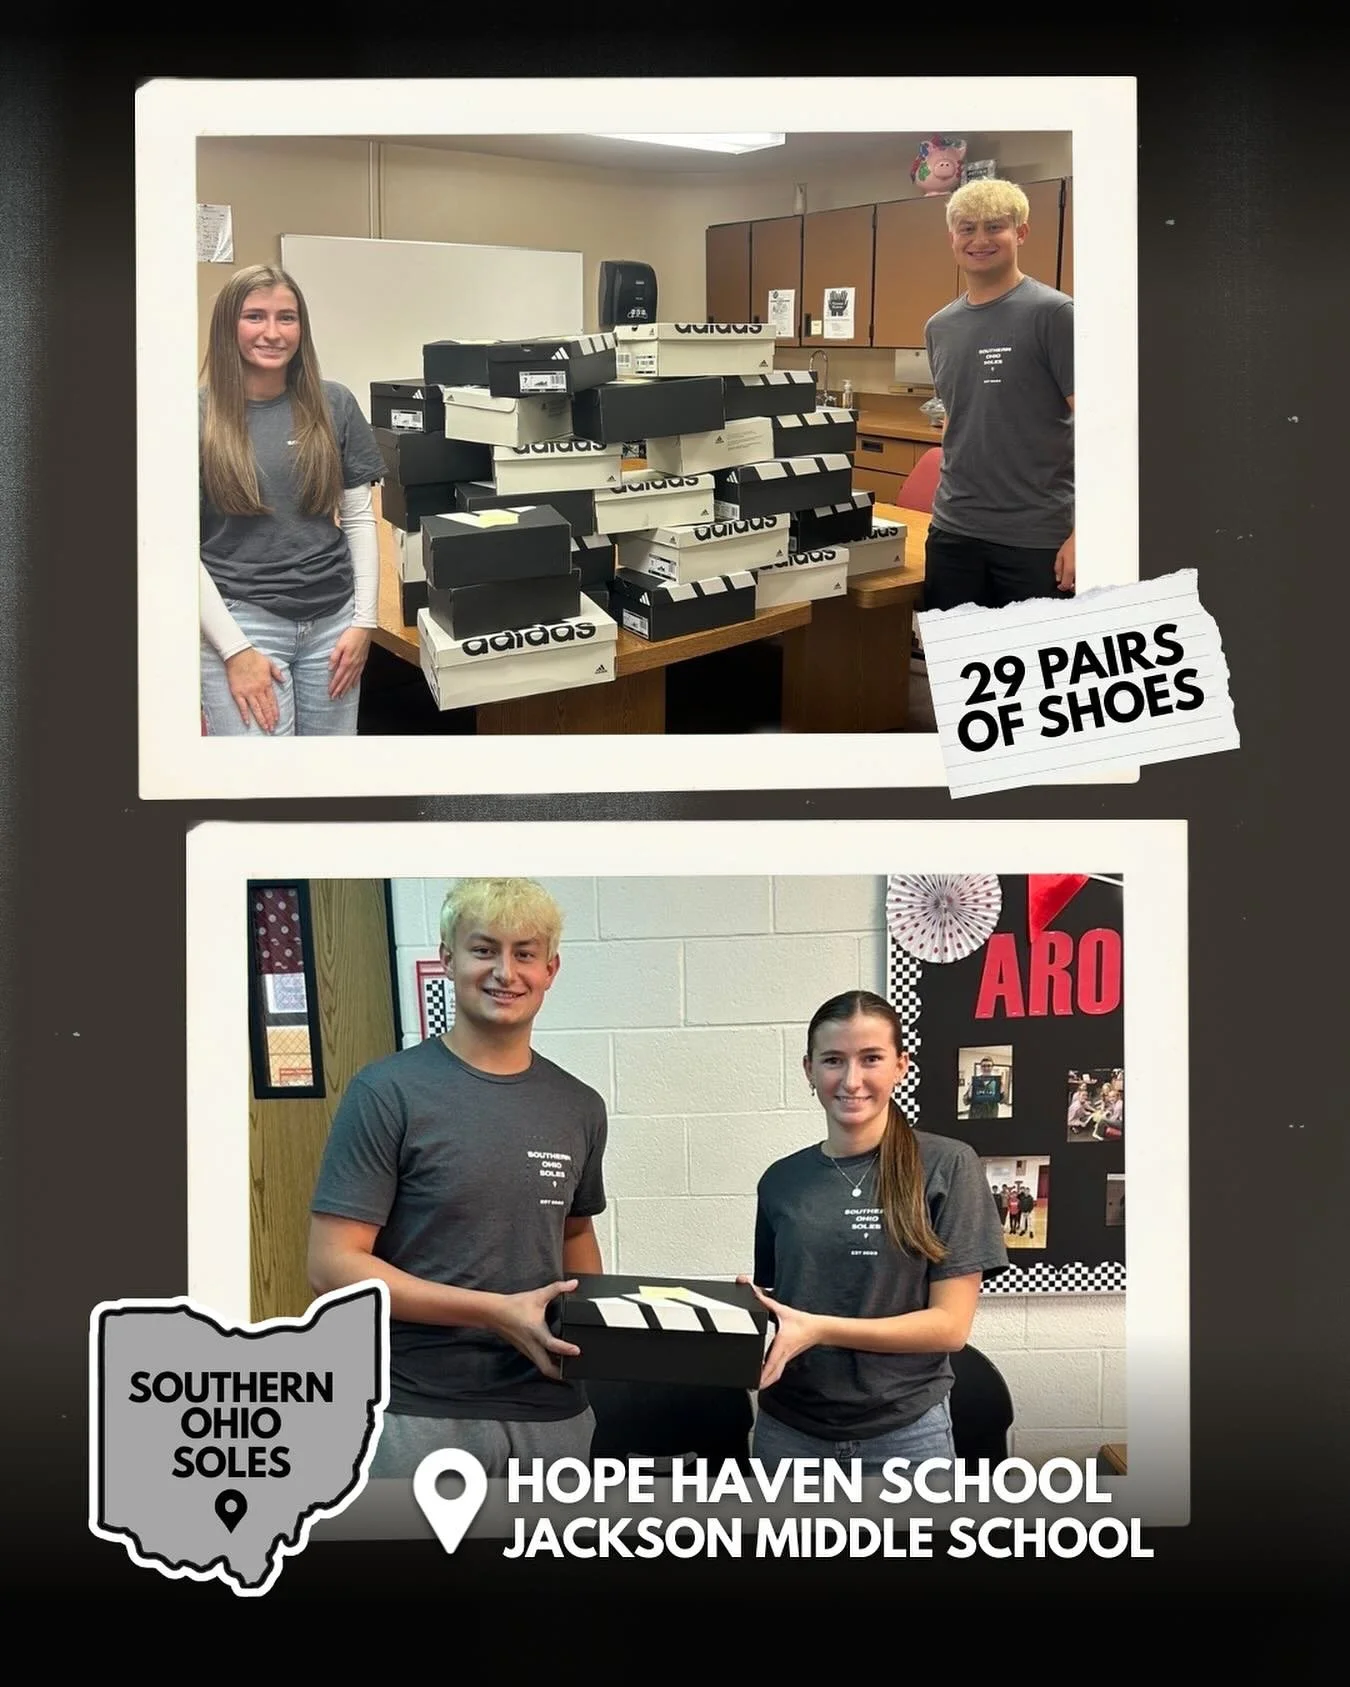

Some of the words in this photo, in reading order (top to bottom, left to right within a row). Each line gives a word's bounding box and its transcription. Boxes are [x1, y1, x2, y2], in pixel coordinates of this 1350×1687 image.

[462, 622, 597, 657] adidas
[974, 928, 1122, 1019] ARO
[527, 1151, 572, 1161] SOUTHERN
[541, 1161, 563, 1169] OHIO
[539, 1170, 566, 1178] SOLES
